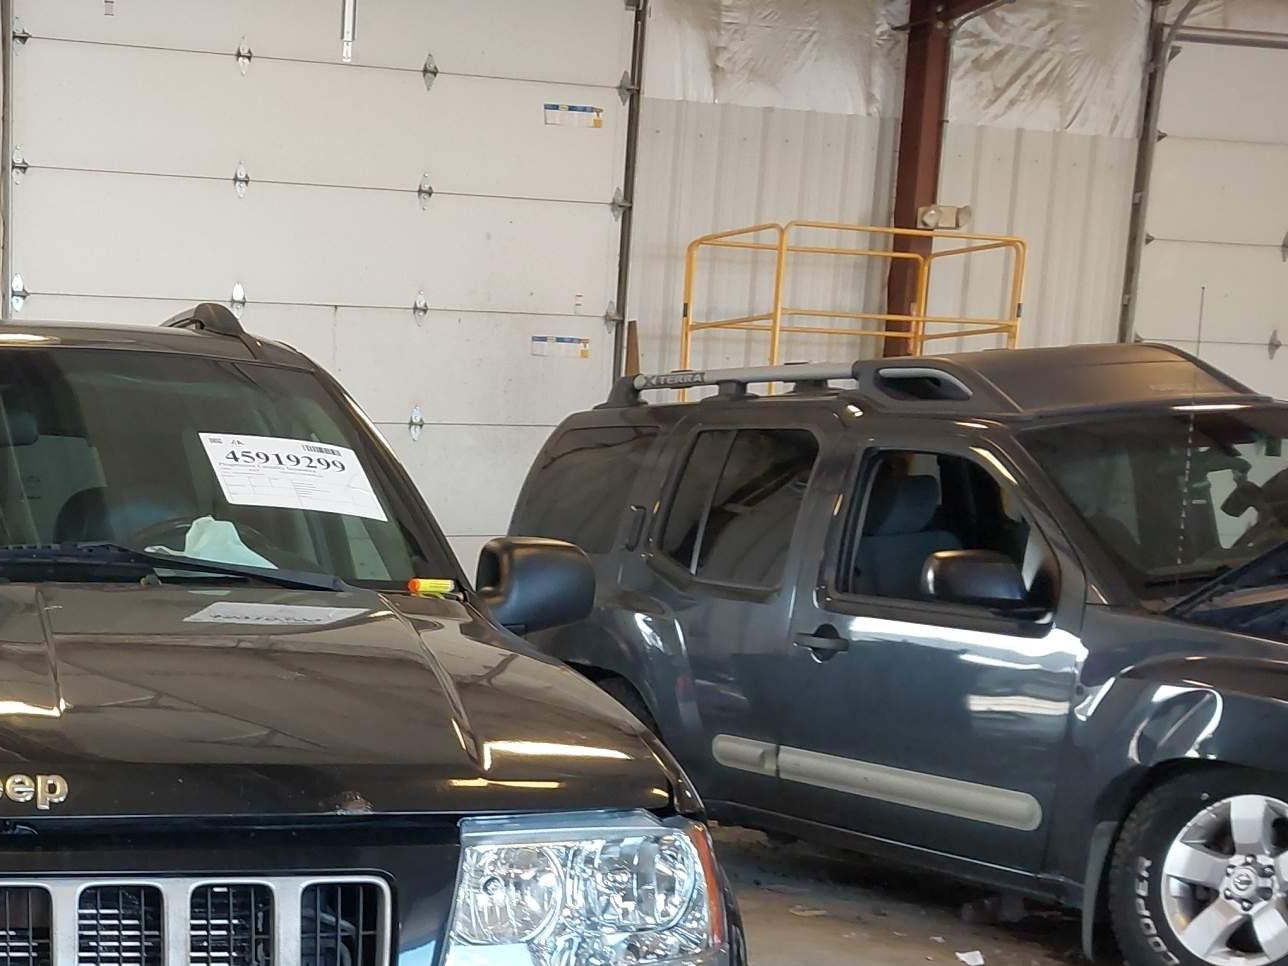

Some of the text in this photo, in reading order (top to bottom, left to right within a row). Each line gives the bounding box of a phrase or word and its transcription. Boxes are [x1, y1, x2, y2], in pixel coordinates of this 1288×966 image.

[644, 374, 702, 388] XTERRA
[224, 449, 346, 473] 45919299
[1135, 855, 1181, 966] COOPER
